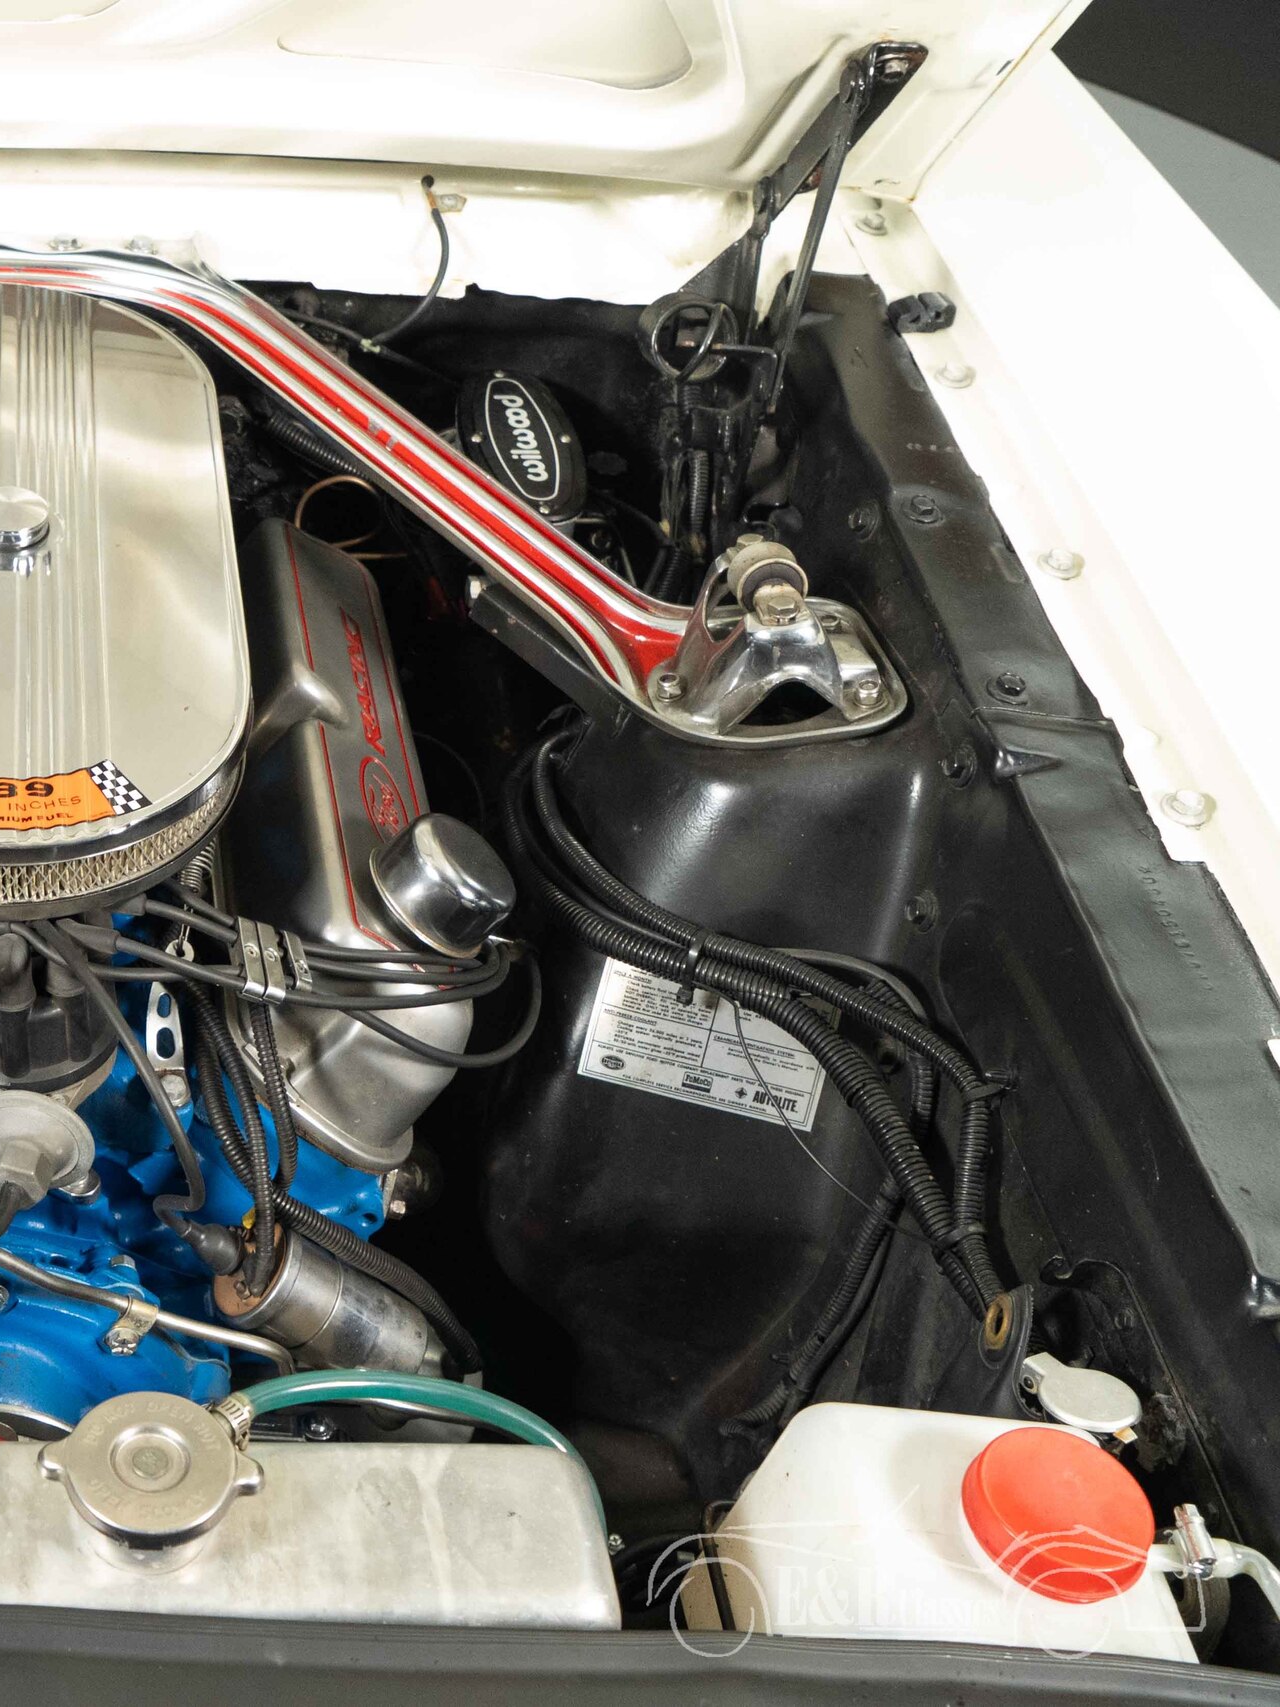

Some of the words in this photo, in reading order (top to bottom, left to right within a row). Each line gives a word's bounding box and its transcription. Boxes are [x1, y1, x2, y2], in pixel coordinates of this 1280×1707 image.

[493, 394, 548, 482] wilwood
[8, 795, 82, 811] INCHES
[37, 811, 74, 822] FUEL
